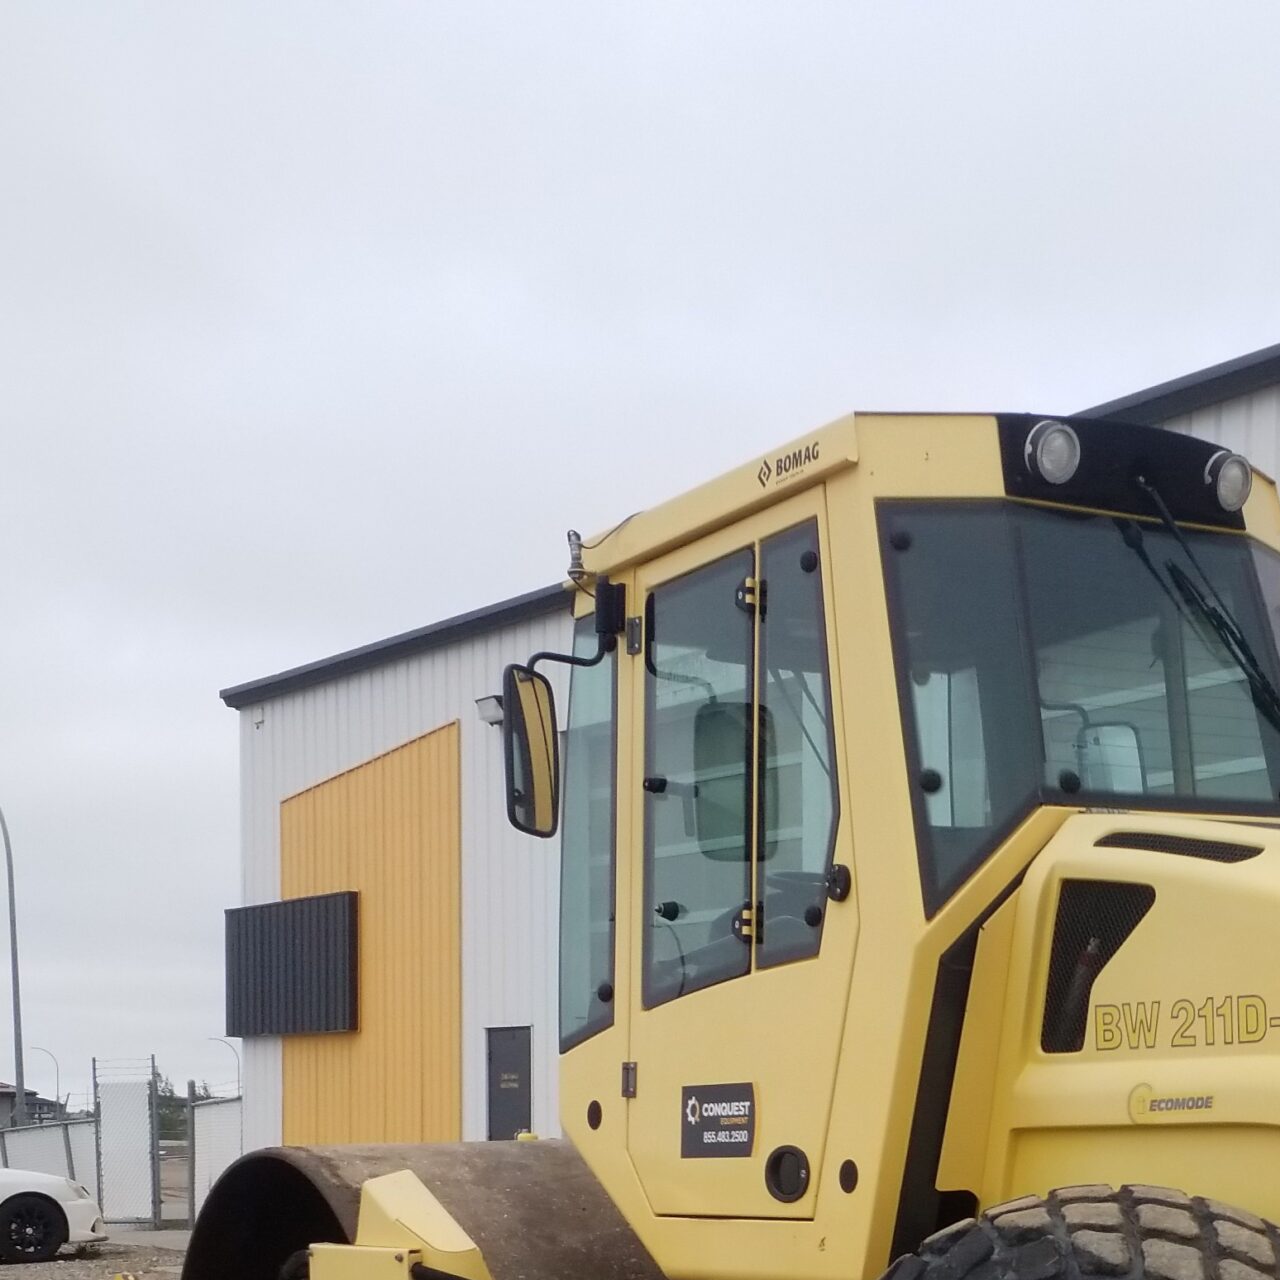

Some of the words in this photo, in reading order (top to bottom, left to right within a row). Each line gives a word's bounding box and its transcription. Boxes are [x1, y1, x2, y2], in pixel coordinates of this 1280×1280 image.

[775, 441, 819, 477] BOMAG
[1095, 1001, 1161, 1051] BW
[701, 1101, 751, 1117] CONQUEST
[1149, 1096, 1213, 1112] ECOMODE
